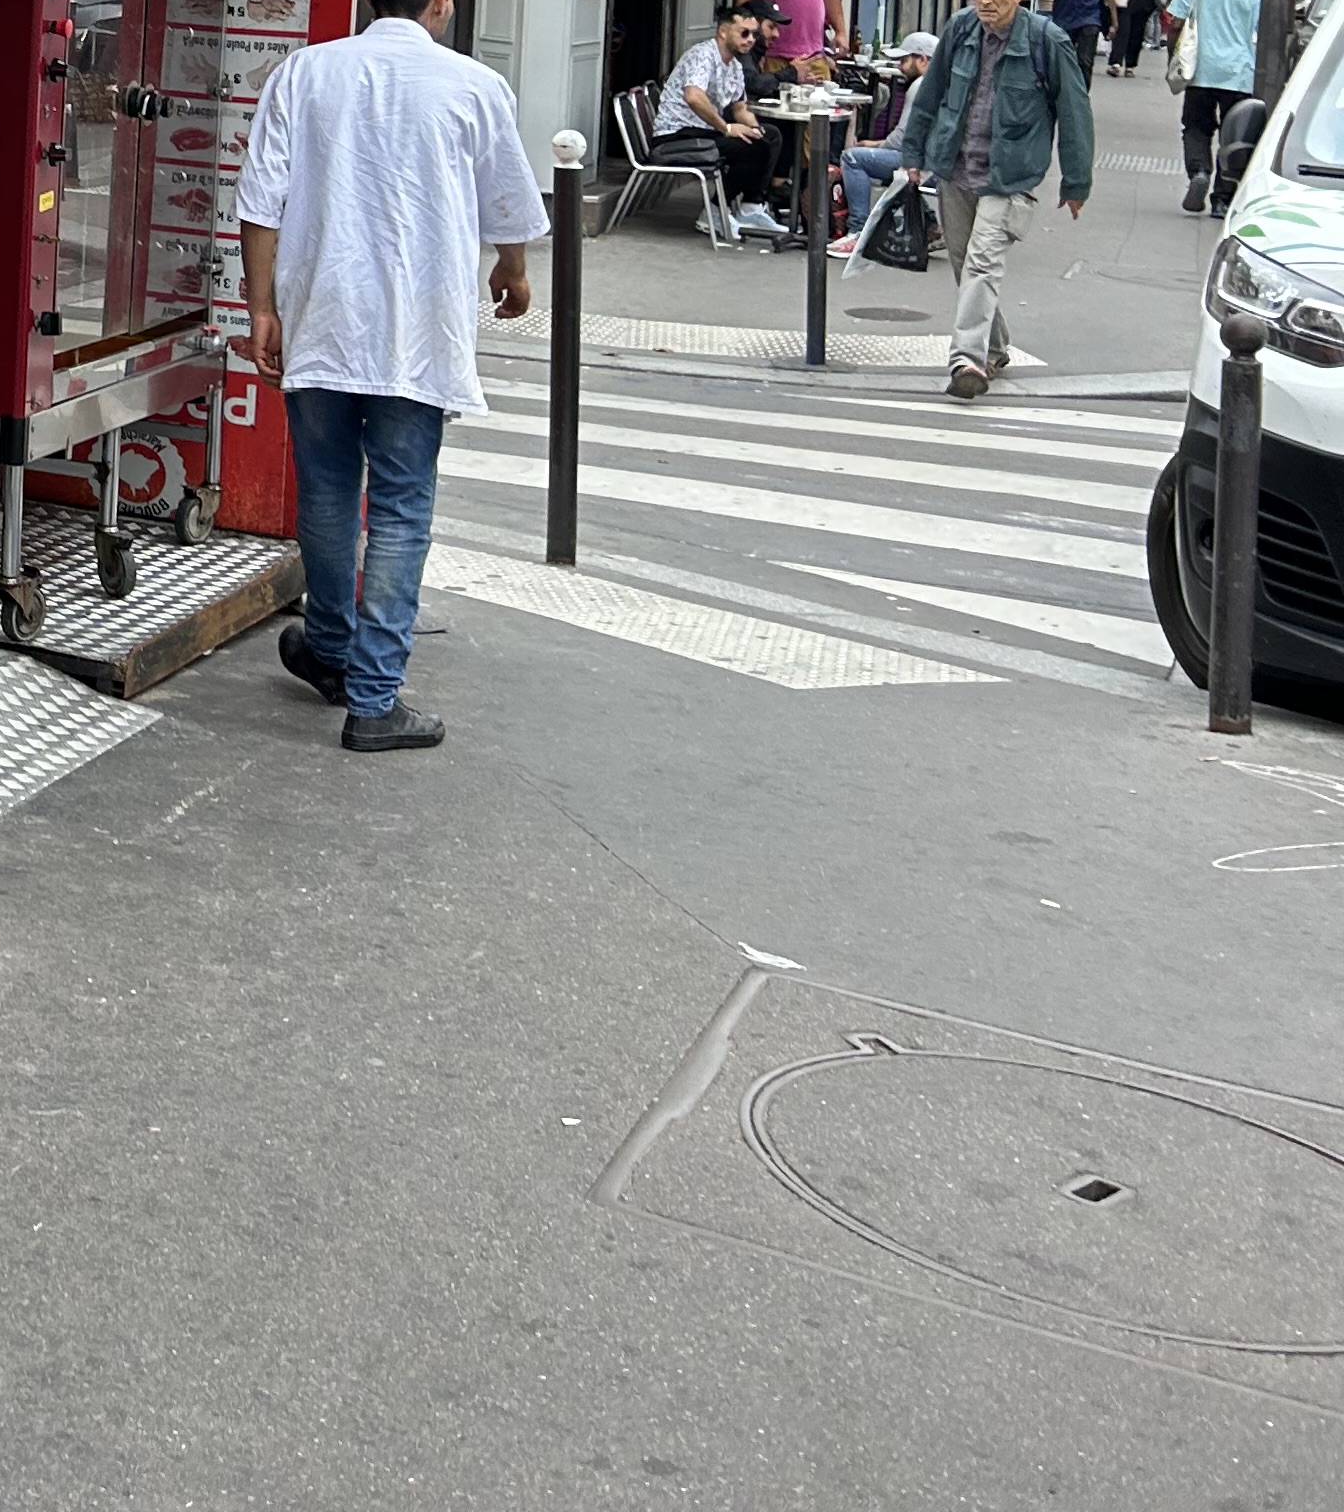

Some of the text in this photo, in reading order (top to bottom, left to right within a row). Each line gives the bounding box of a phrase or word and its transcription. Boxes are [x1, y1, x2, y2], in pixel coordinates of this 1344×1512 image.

[226, 39, 251, 52] Poule
[253, 41, 265, 53] de
[216, 314, 251, 326] sans os
